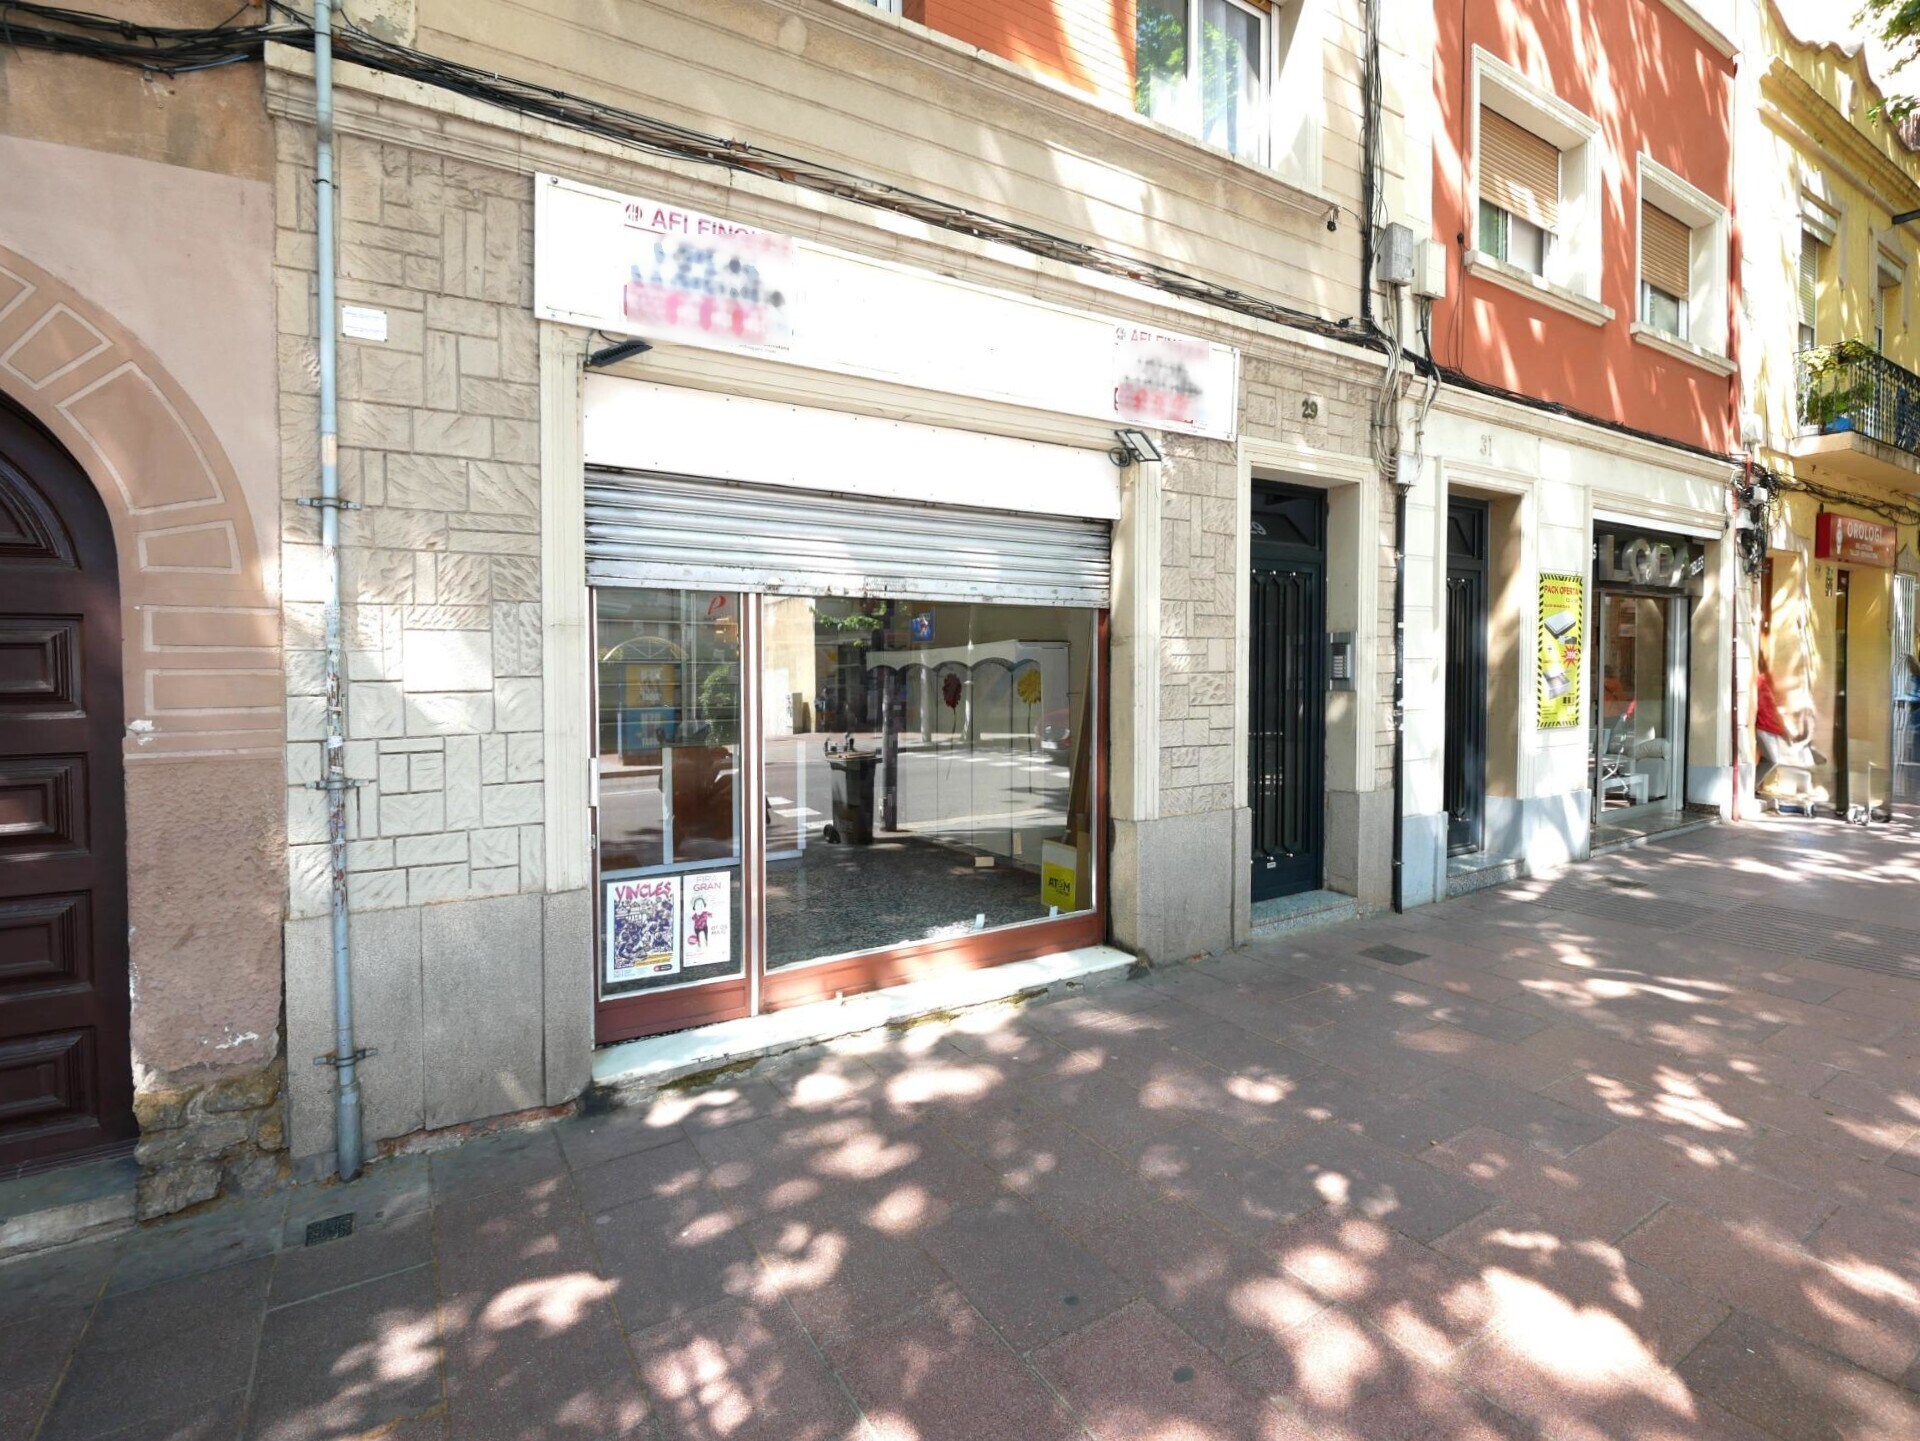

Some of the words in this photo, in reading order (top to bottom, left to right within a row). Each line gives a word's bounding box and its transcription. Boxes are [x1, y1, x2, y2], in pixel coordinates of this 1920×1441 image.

[651, 208, 688, 234] AFI
[1301, 398, 1318, 419] 29
[1847, 521, 1882, 542] OROLOGI
[1544, 585, 1559, 594] PACK
[1559, 586, 1578, 595] OFERTA
[615, 881, 672, 900] VINCLES
[693, 882, 722, 892] GRAN
